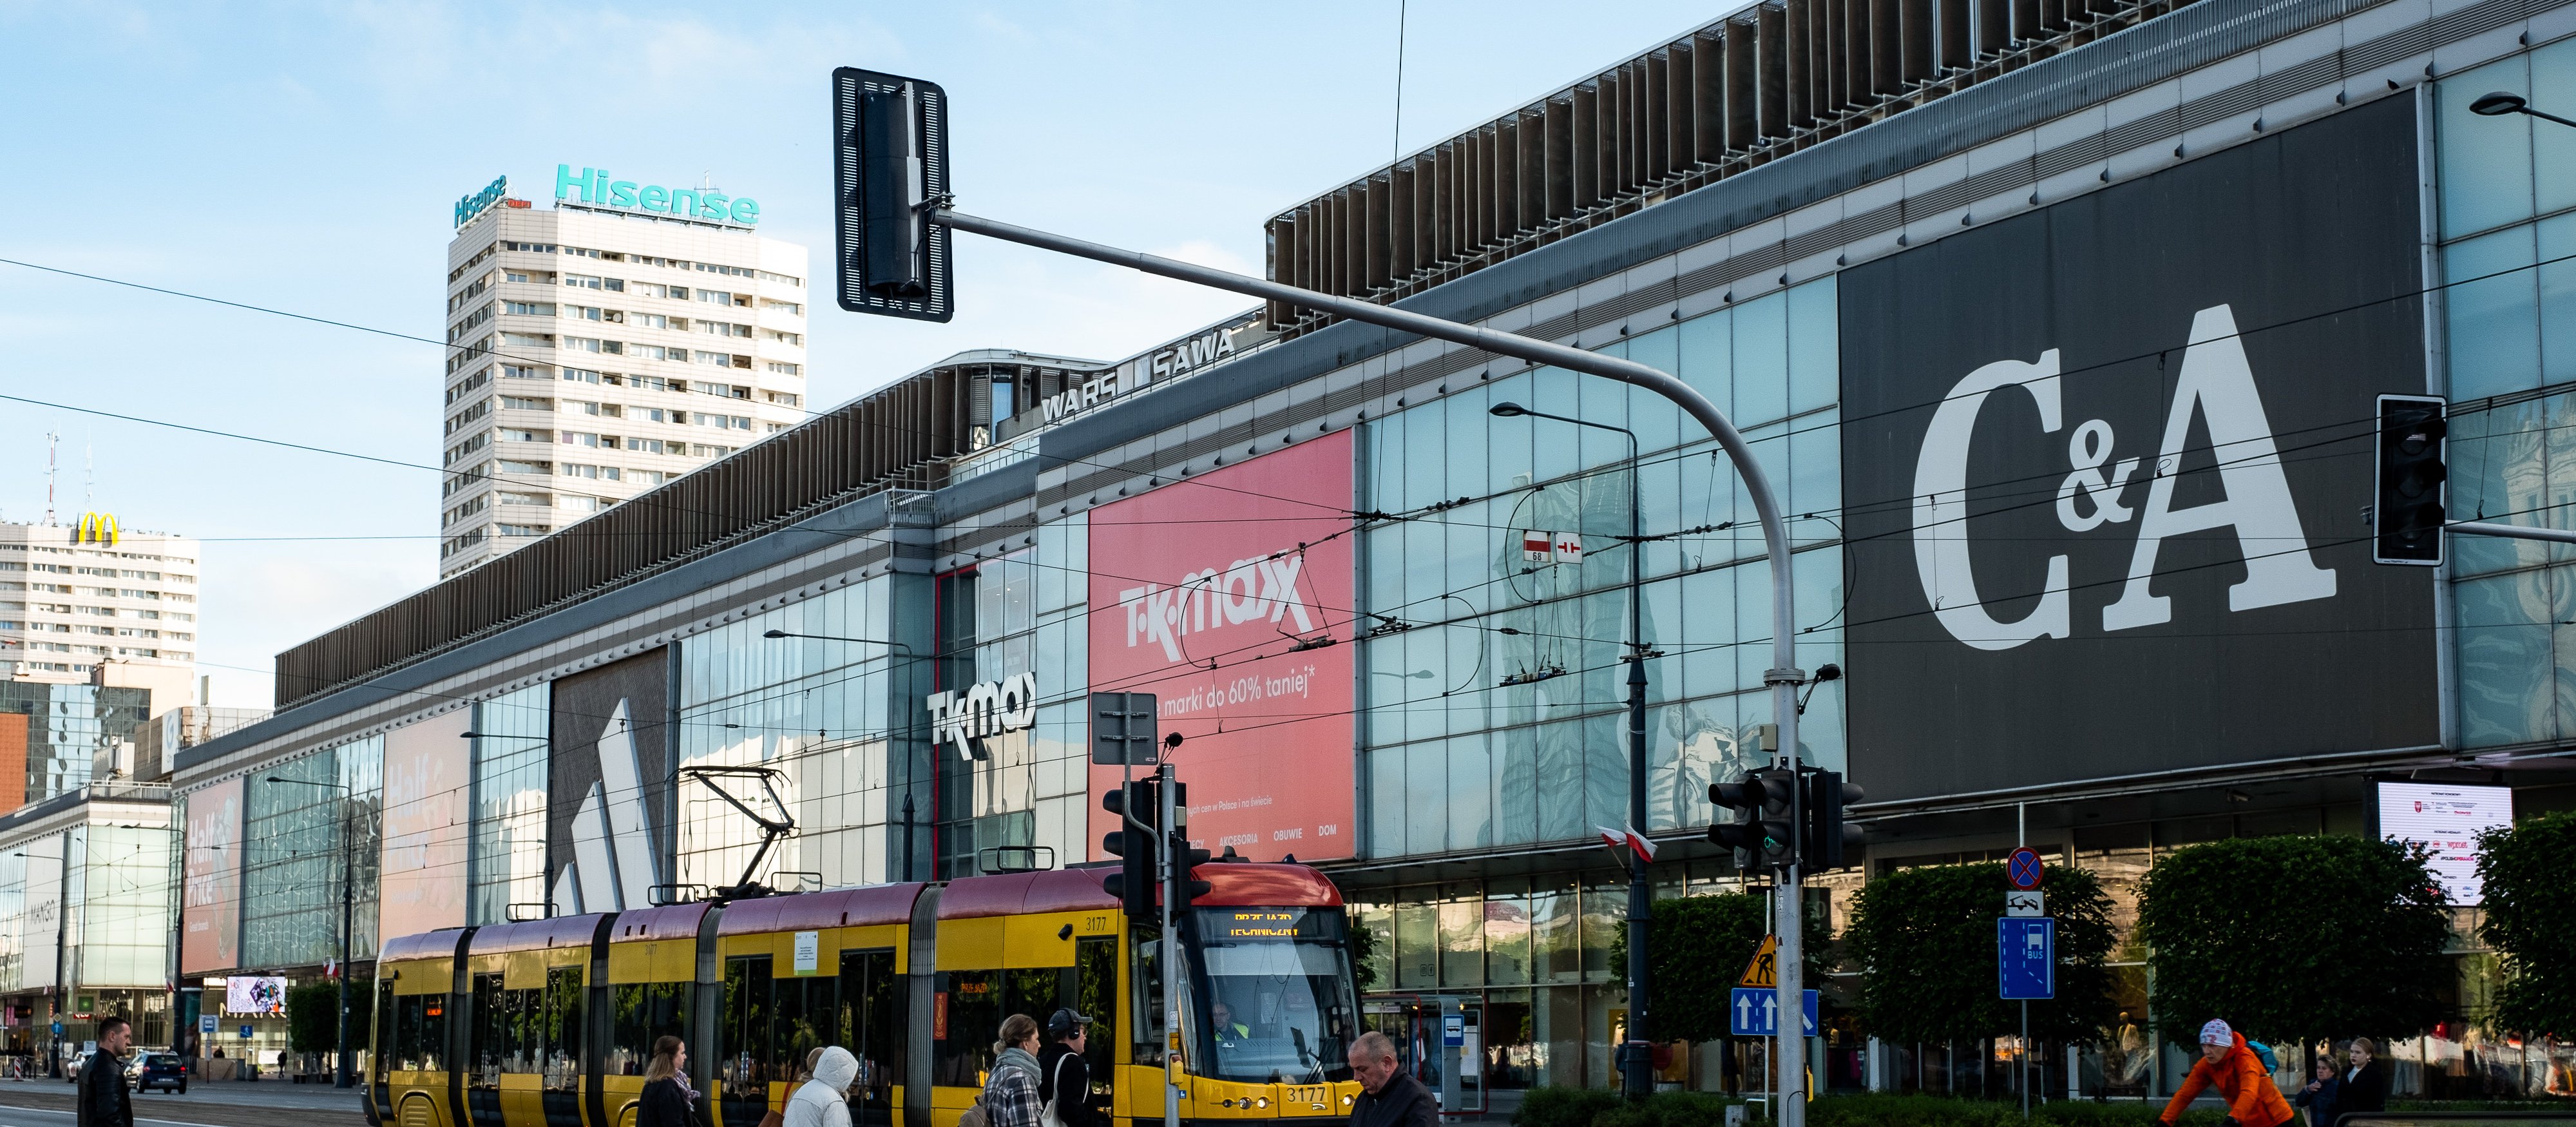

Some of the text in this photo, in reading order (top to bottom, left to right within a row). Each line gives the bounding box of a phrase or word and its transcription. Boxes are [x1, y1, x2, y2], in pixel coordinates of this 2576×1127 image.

[454, 175, 506, 229] Hisense
[555, 164, 760, 224] Hisense
[1042, 329, 1235, 422] WARS SAWA
[1913, 303, 2336, 650] C&A
[1532, 552, 1542, 561] 68
[1165, 686, 1202, 717] marki
[1206, 684, 1225, 708] do
[1228, 675, 1261, 704] 60%
[1201, 804, 1211, 813] cen
[1219, 800, 1237, 811] Polsce
[1241, 800, 1250, 808] na
[1250, 795, 1272, 807] świecie
[189, 811, 215, 865] Half
[1219, 833, 1258, 847] AKCESORIA
[1274, 827, 1302, 842] OBUWIE
[1319, 824, 1337, 837] DOM
[187, 867, 213, 908] Price
[30, 900, 55, 925] MANGO
[1085, 916, 1107, 931] 3177
[2027, 950, 2043, 959] BUS
[1286, 1087, 1326, 1103] 3177
